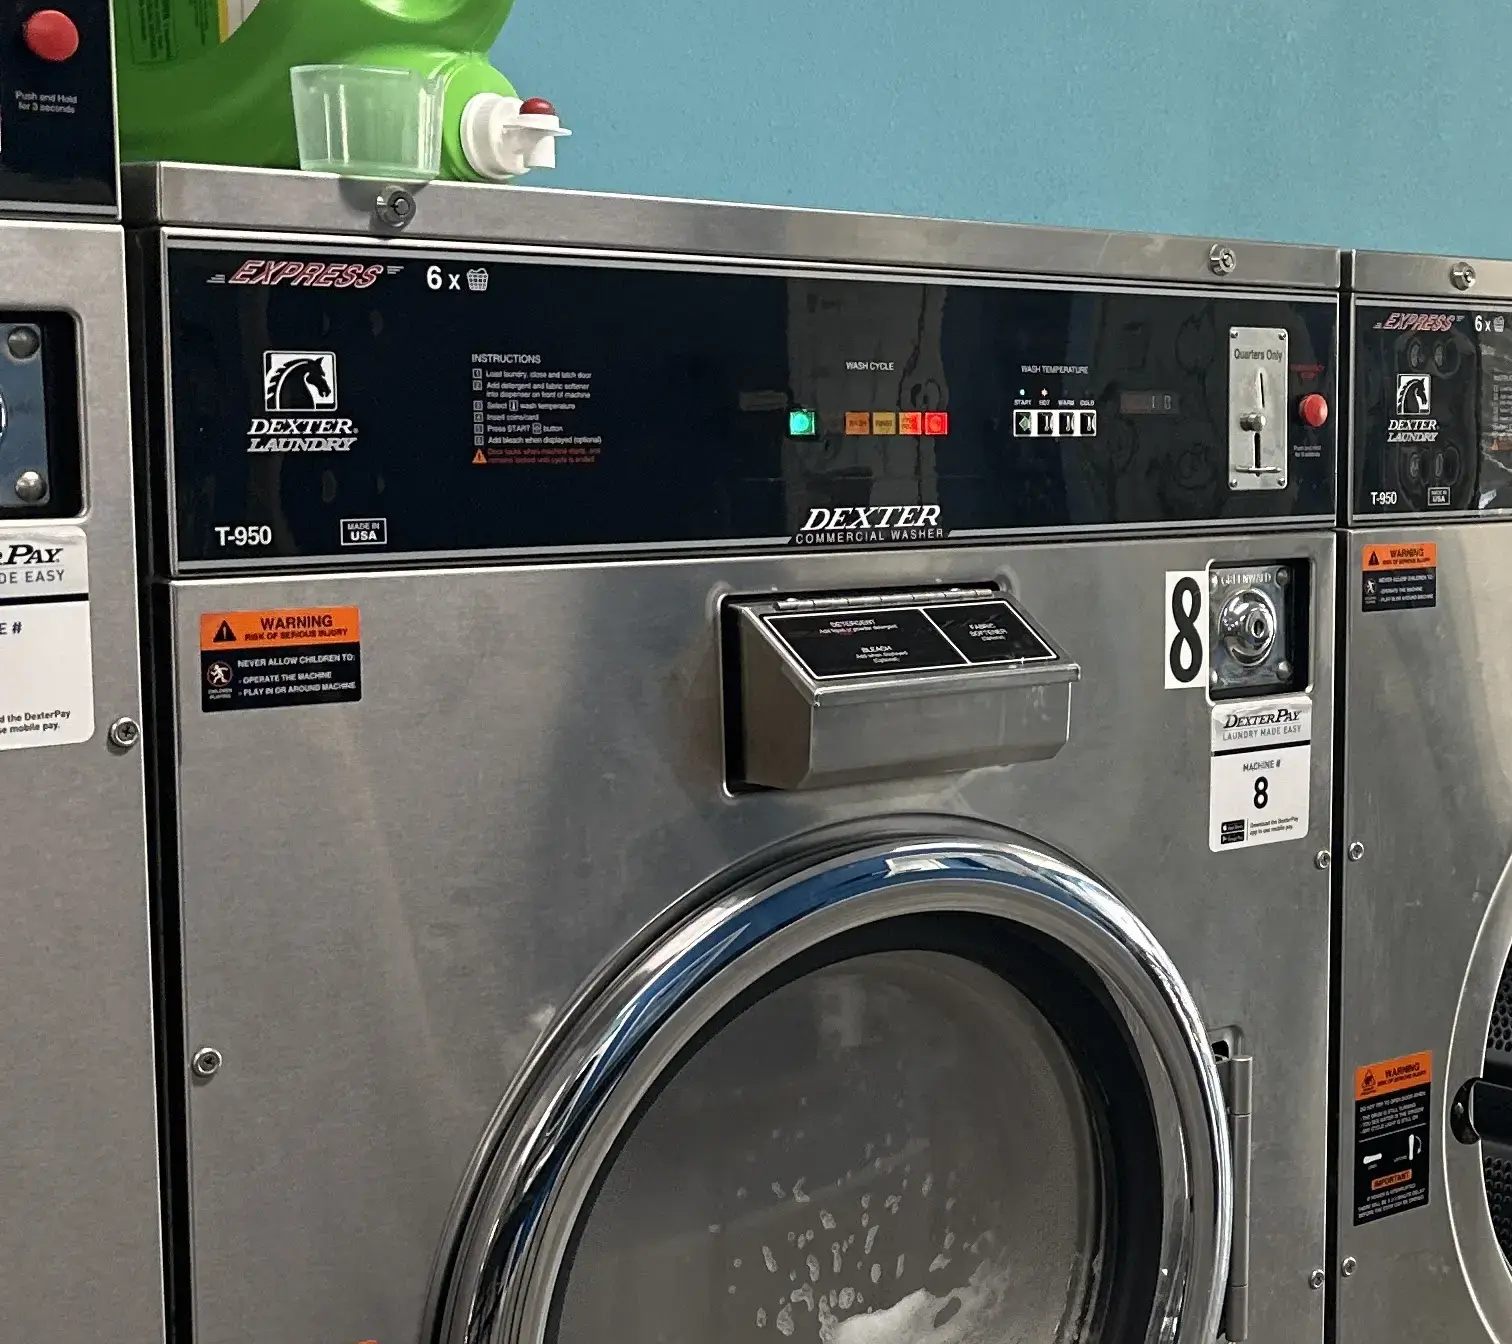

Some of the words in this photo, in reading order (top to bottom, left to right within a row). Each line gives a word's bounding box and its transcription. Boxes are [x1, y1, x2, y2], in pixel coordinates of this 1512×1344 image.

[15, 91, 37, 100] Push
[58, 94, 77, 104] Hold
[228, 260, 384, 288] EXPRESS
[426, 266, 442, 290] 6
[449, 274, 460, 290] x
[1383, 313, 1455, 331] EXPRESS
[1475, 315, 1482, 332] 6
[1485, 321, 1491, 331] x
[472, 354, 541, 364] INSTRUCTIONS
[1234, 348, 1264, 361] Quarters
[1267, 349, 1282, 362] Only
[846, 362, 868, 370] WASH
[870, 362, 894, 371] CYCLE
[1021, 365, 1040, 373] WASH
[1042, 366, 1088, 374] TEMPERATURE
[247, 418, 354, 435] DEXTER
[1388, 419, 1437, 431] DEXTER
[1387, 432, 1438, 442] LAUNDRY
[247, 437, 357, 452] LAUNDRY
[1371, 492, 1397, 505] T-950
[801, 505, 941, 530] DEXTER
[214, 525, 272, 546] T-950
[350, 530, 378, 540] USA
[795, 530, 884, 544] COMMERCIAL
[891, 529, 943, 540] WASHER
[25, 569, 64, 583] EASY
[12, 621, 22, 634] #
[261, 615, 333, 630] WARNING
[1170, 576, 1203, 682] 8
[245, 632, 264, 641] RISK
[267, 631, 277, 640] OF
[281, 630, 316, 640] SERIOUS
[318, 628, 347, 637] INJURY
[238, 658, 266, 667] NEVER
[268, 657, 297, 666] ALLOW
[299, 655, 340, 664] CHILDREN
[243, 674, 279, 683] OPERATE
[281, 673, 296, 682] THE
[298, 672, 331, 680] MACHINE
[243, 688, 264, 696] PLAY
[266, 687, 273, 695] IN
[275, 686, 286, 694] OR
[288, 684, 321, 693] AROUND
[322, 682, 356, 691] MACHINE
[7, 714, 22, 722] the
[25, 710, 70, 720] DexterPay
[10, 723, 40, 732] mobile
[1223, 730, 1257, 741] LAUNDRY
[1261, 726, 1280, 737] MADE
[1284, 725, 1301, 734] EASY
[1243, 760, 1274, 772] MACHINE
[1254, 776, 1268, 809] 8
[1385, 1062, 1420, 1078] WARNING
